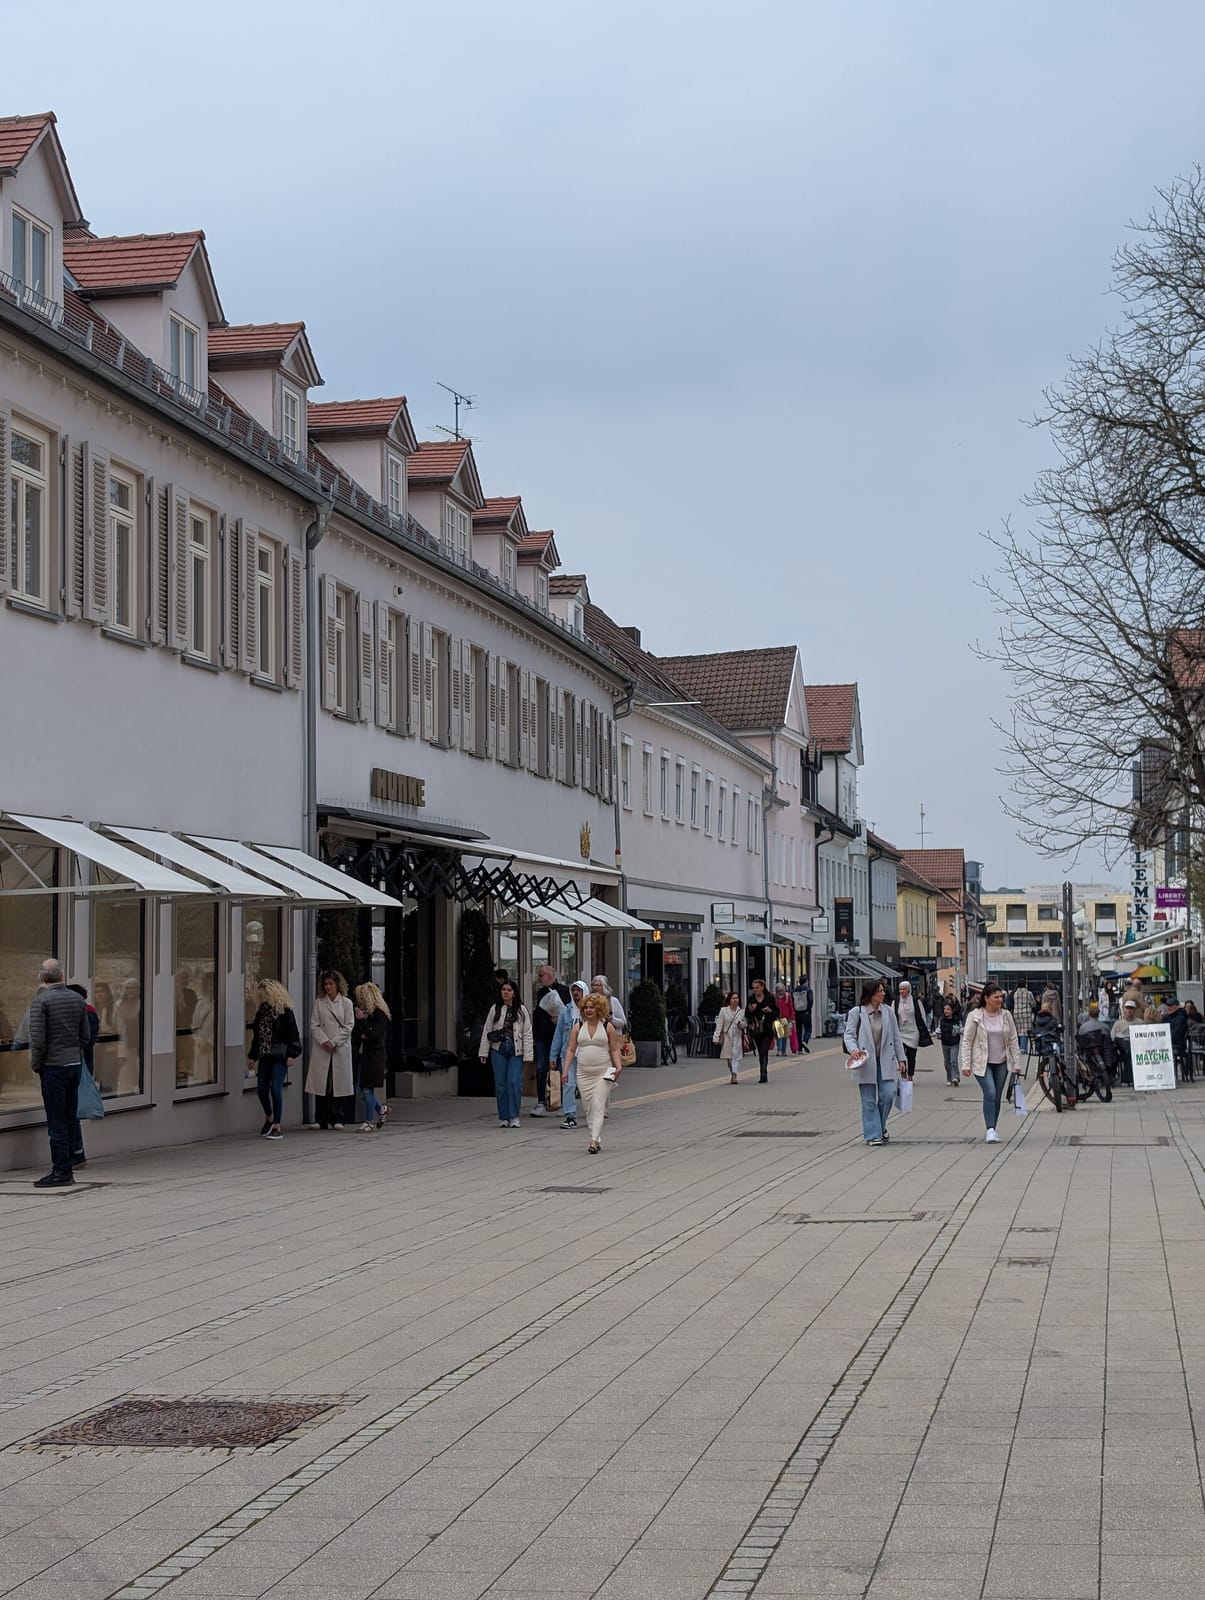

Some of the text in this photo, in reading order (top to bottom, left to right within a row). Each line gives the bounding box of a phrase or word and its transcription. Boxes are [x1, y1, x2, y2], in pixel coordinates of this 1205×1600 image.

[1134, 852, 1149, 932] LEMKE
[1021, 948, 1063, 957] MARSTA
[1136, 1053, 1169, 1062] MATCHA
